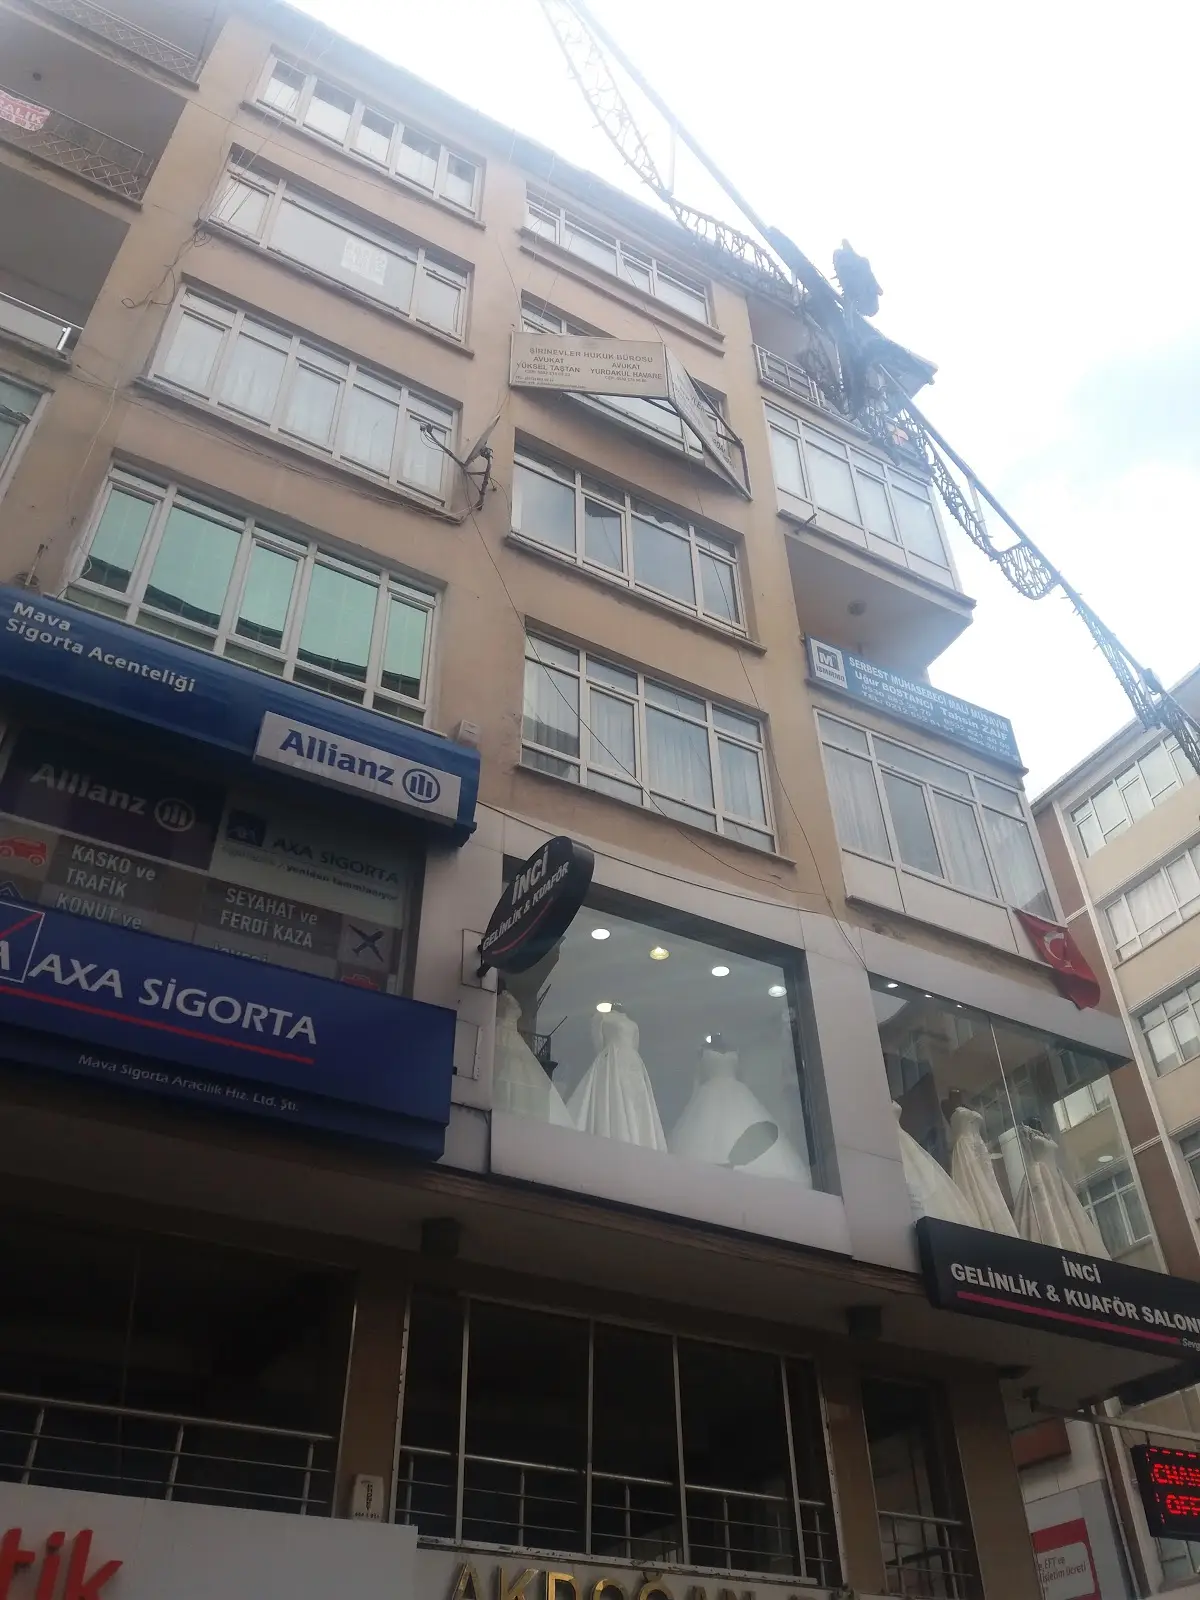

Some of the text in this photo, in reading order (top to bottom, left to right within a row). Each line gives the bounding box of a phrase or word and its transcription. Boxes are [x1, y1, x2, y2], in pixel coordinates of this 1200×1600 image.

[533, 356, 564, 364] AVUKAT
[583, 351, 614, 360] HUKUK
[589, 368, 631, 377] YURDAKUL
[611, 362, 641, 370] AVUKAT
[12, 601, 72, 631] Mava
[5, 618, 197, 694] Sigorta Acenteliği
[849, 656, 888, 681] SERBEST
[854, 671, 880, 689] Uğur
[882, 682, 935, 711] BOSTANCI
[939, 706, 980, 730] Tahsin
[279, 728, 395, 787] Allianz
[29, 762, 147, 817] Allianz
[71, 843, 157, 881] KASKO ve
[271, 837, 314, 860] AXA
[65, 867, 128, 899] TRAFİK
[511, 845, 549, 905] İNCİ
[56, 893, 143, 930] KONUT ve
[225, 887, 318, 927] SEYAHAT ve
[219, 908, 314, 950] FERDİ KAZA
[482, 908, 522, 951] GELİNLİK
[28, 953, 124, 999] AXA
[138, 976, 318, 1045] SİGORTA
[78, 1053, 118, 1074] Mava
[120, 1063, 169, 1086] Sigorta
[1061, 1255, 1102, 1284] İNCİ
[950, 1262, 1200, 1335] GELİNLİK & KUAFÖR SALON
